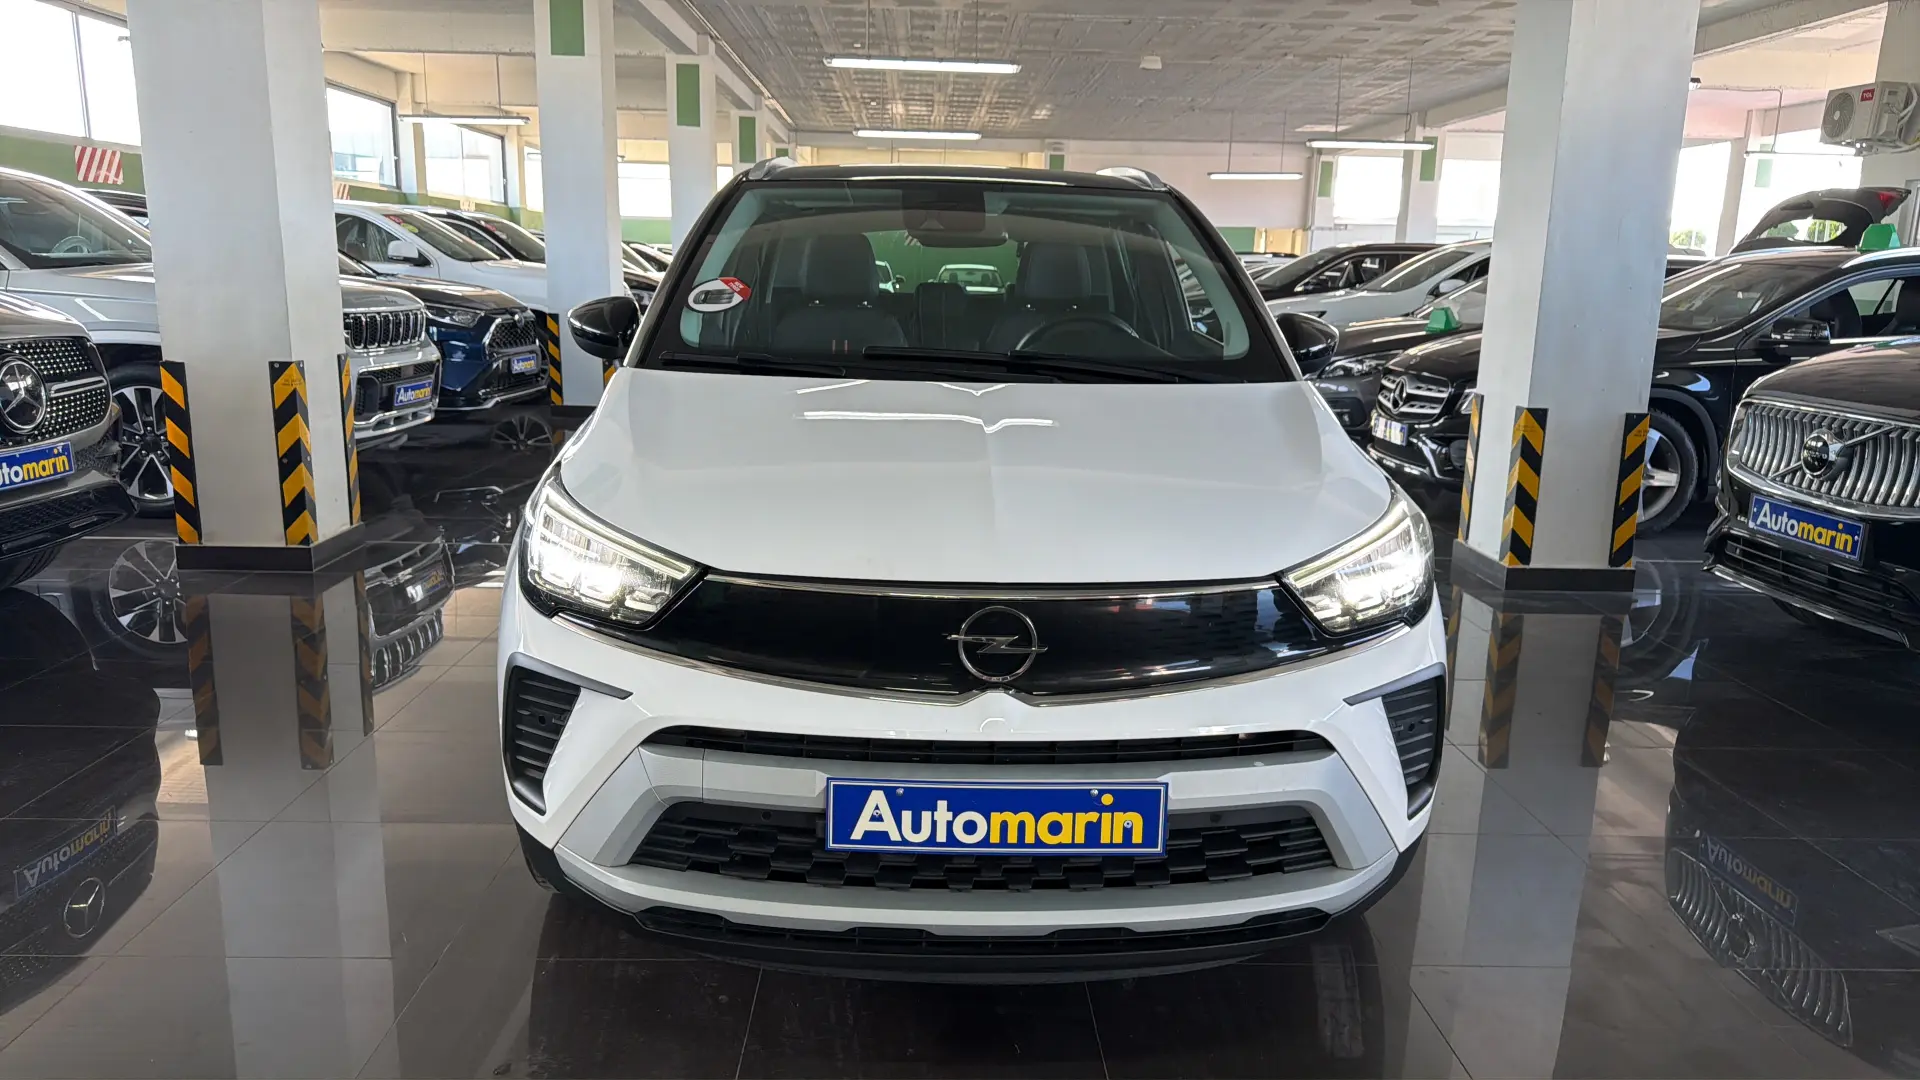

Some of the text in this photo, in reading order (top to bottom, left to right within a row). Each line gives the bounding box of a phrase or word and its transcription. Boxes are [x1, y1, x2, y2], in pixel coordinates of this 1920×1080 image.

[0, 447, 70, 487] tomarin
[1756, 502, 1853, 553] Automarin
[850, 789, 1144, 845] Automarin
